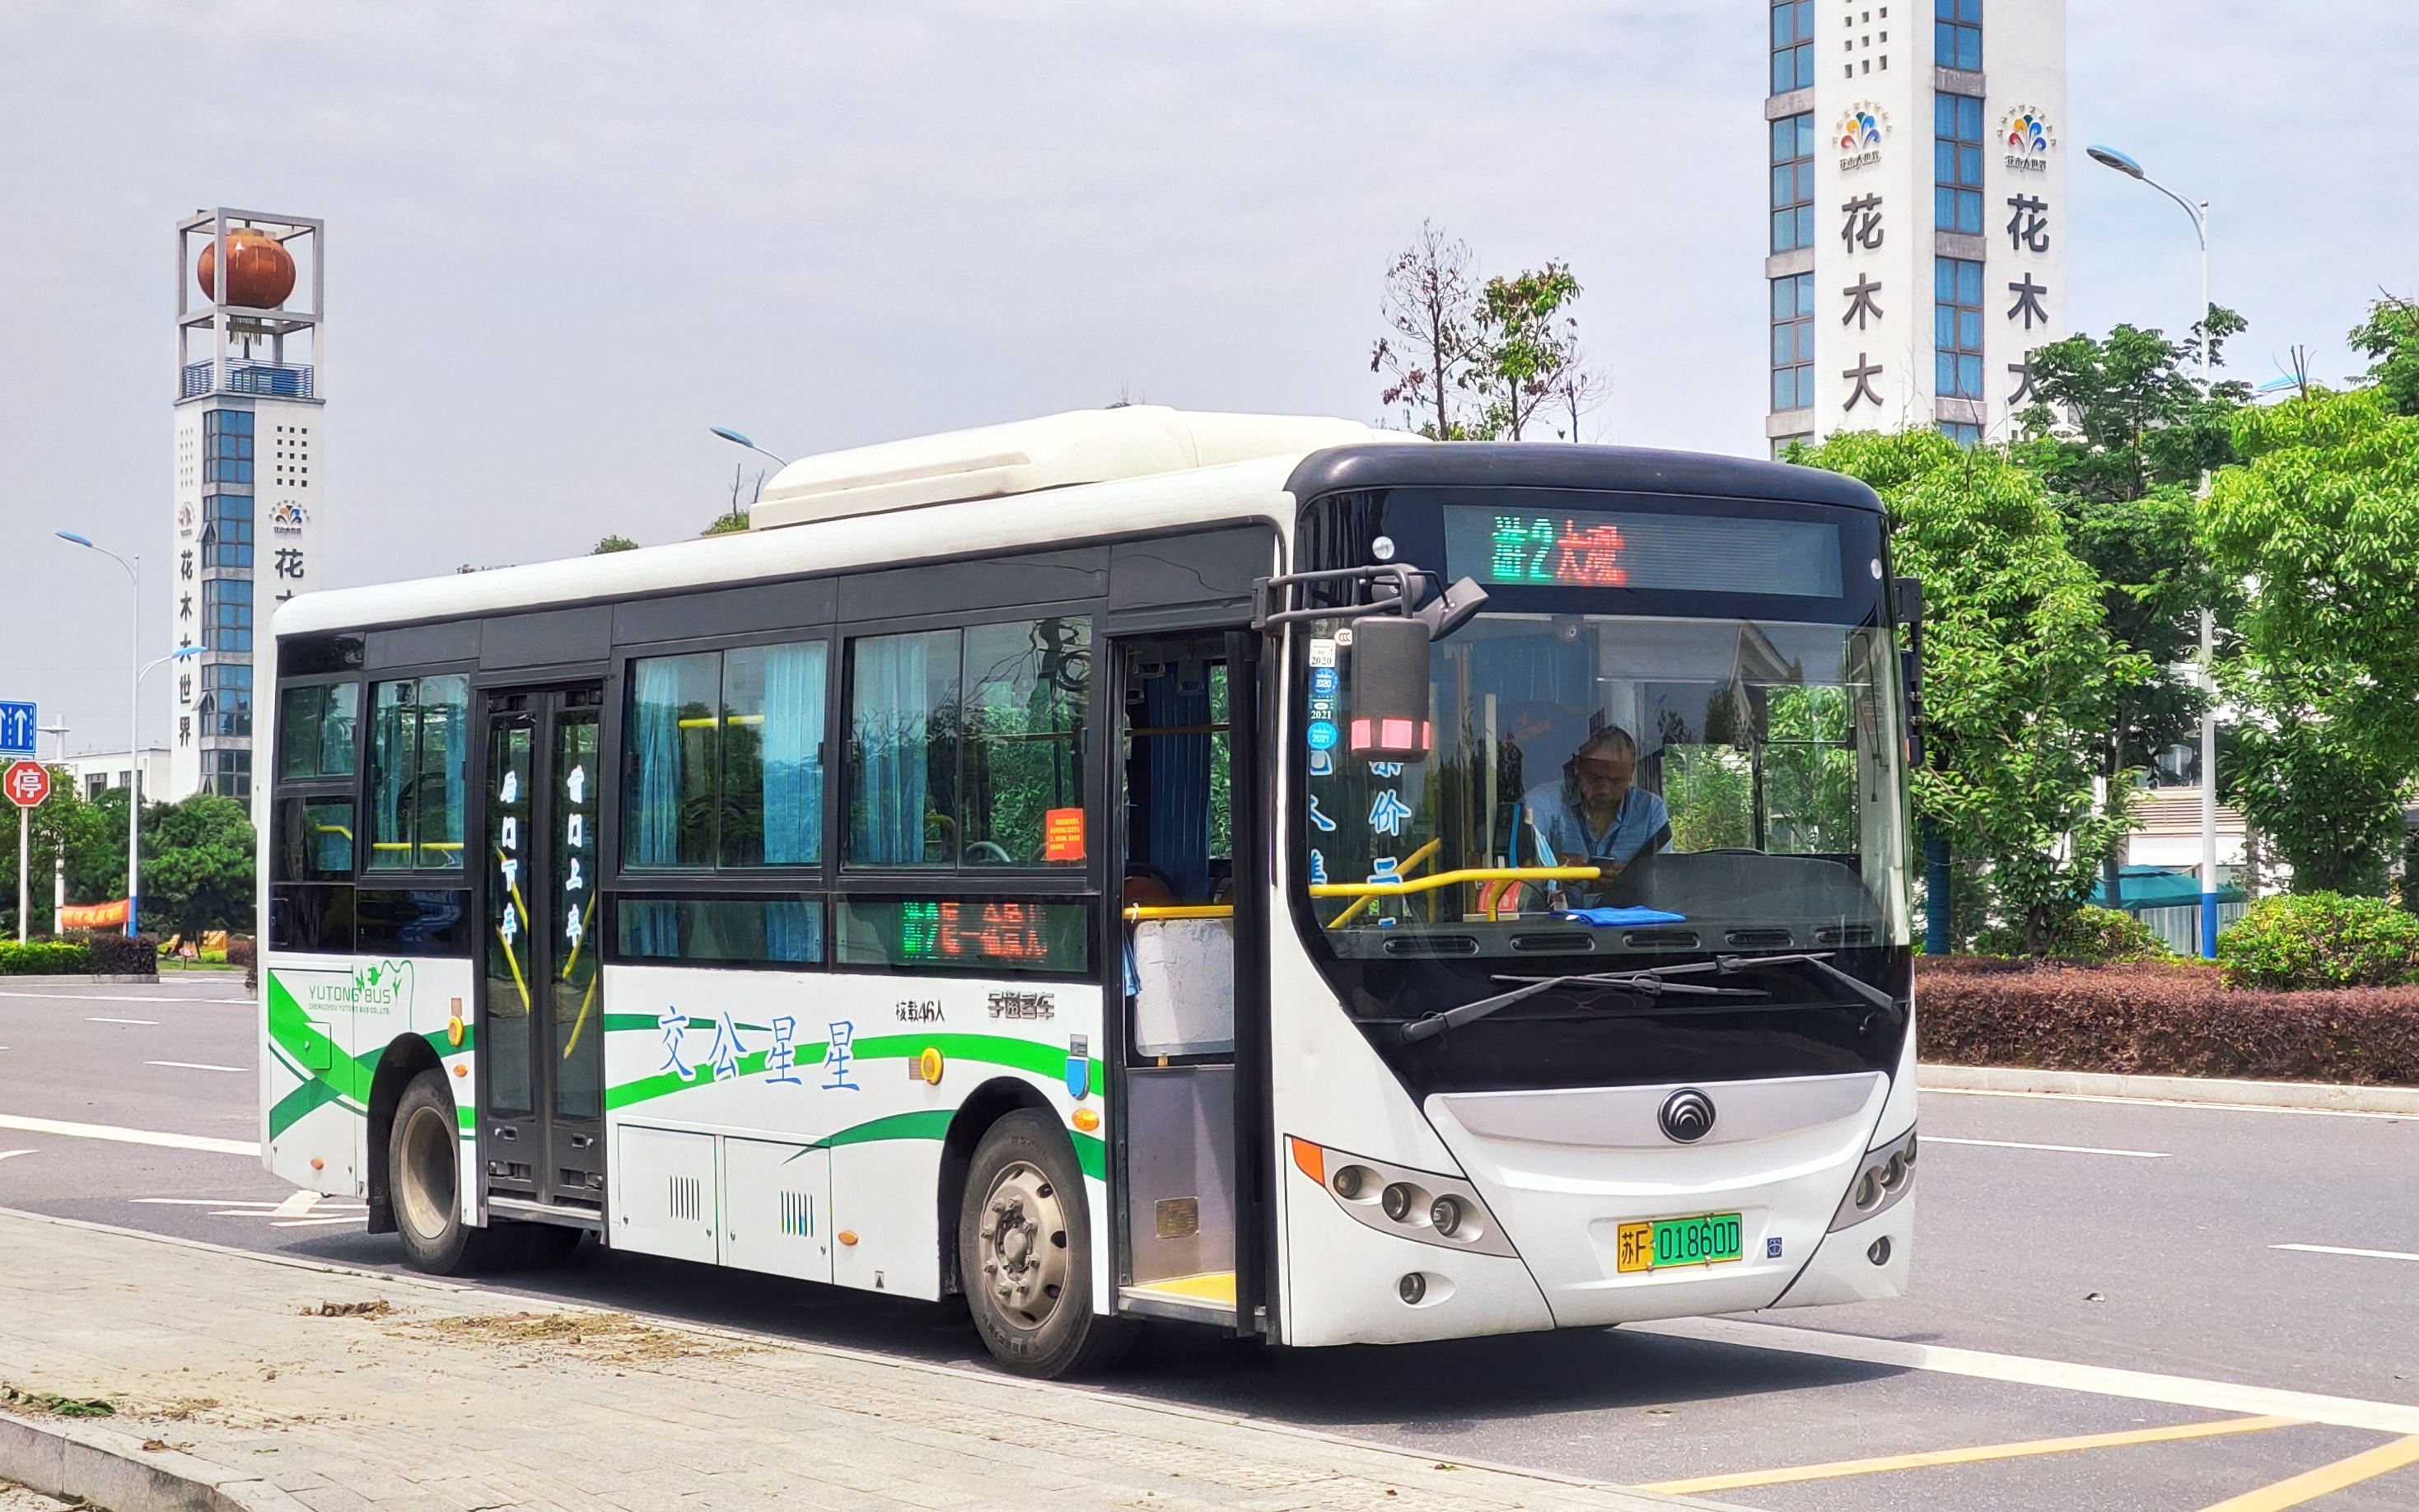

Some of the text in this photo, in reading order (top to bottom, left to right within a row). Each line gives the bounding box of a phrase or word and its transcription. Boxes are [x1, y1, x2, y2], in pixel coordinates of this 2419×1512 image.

[1842, 192, 1884, 411] 花木大
[180, 549, 193, 747] 花木大世界
[1311, 656, 1332, 665] 2020
[1311, 710, 1331, 720] 2021
[13, 768, 41, 798] 停
[309, 986, 391, 1004] YUTONG BUS
[988, 990, 1054, 1020] 宇通客车
[895, 999, 946, 1023] 核载46人
[1622, 1221, 1740, 1264] 苏F 01860D
